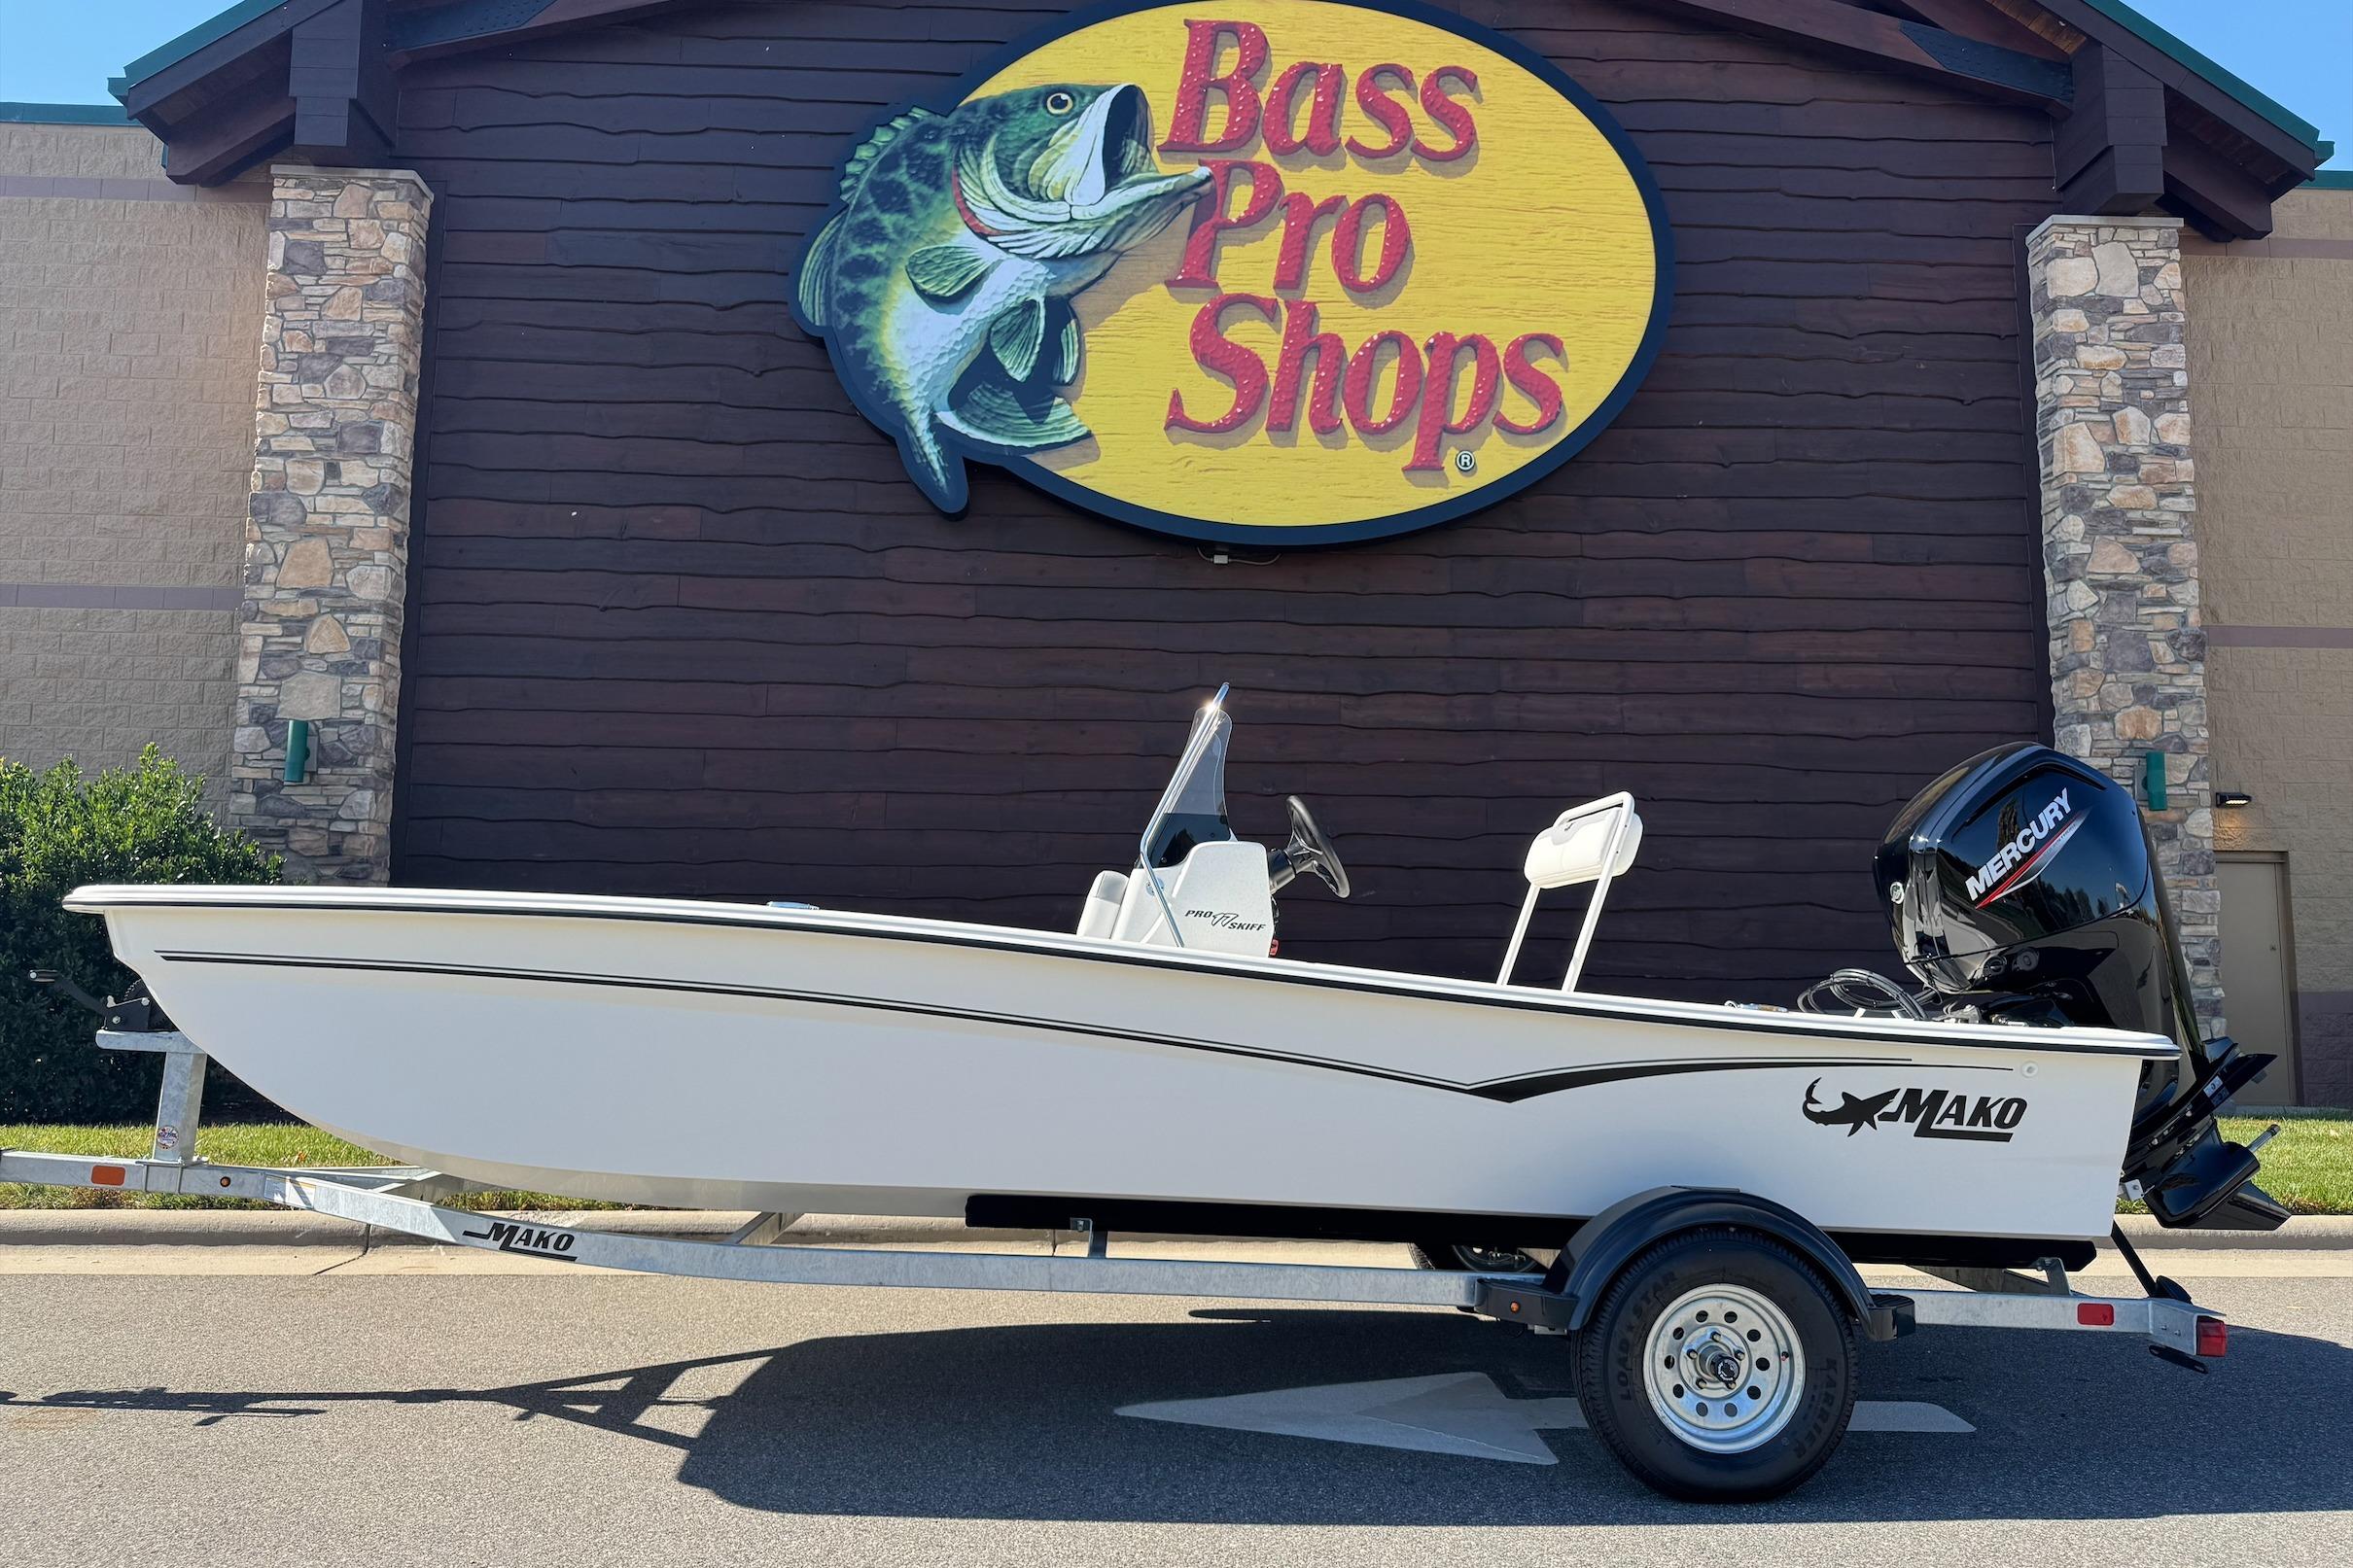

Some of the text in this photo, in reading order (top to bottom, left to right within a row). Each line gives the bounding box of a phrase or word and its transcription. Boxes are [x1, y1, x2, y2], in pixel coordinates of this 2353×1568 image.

[1157, 18, 1478, 161] Bass
[1165, 159, 1411, 294] Pro
[1165, 294, 1564, 471] Shops
[1965, 787, 2071, 901] MERCURY
[1185, 910, 1213, 919] PRO
[1228, 922, 1267, 931] SKIFF
[1878, 1088, 2027, 1142] MAKO
[462, 1222, 578, 1262] MAKO
